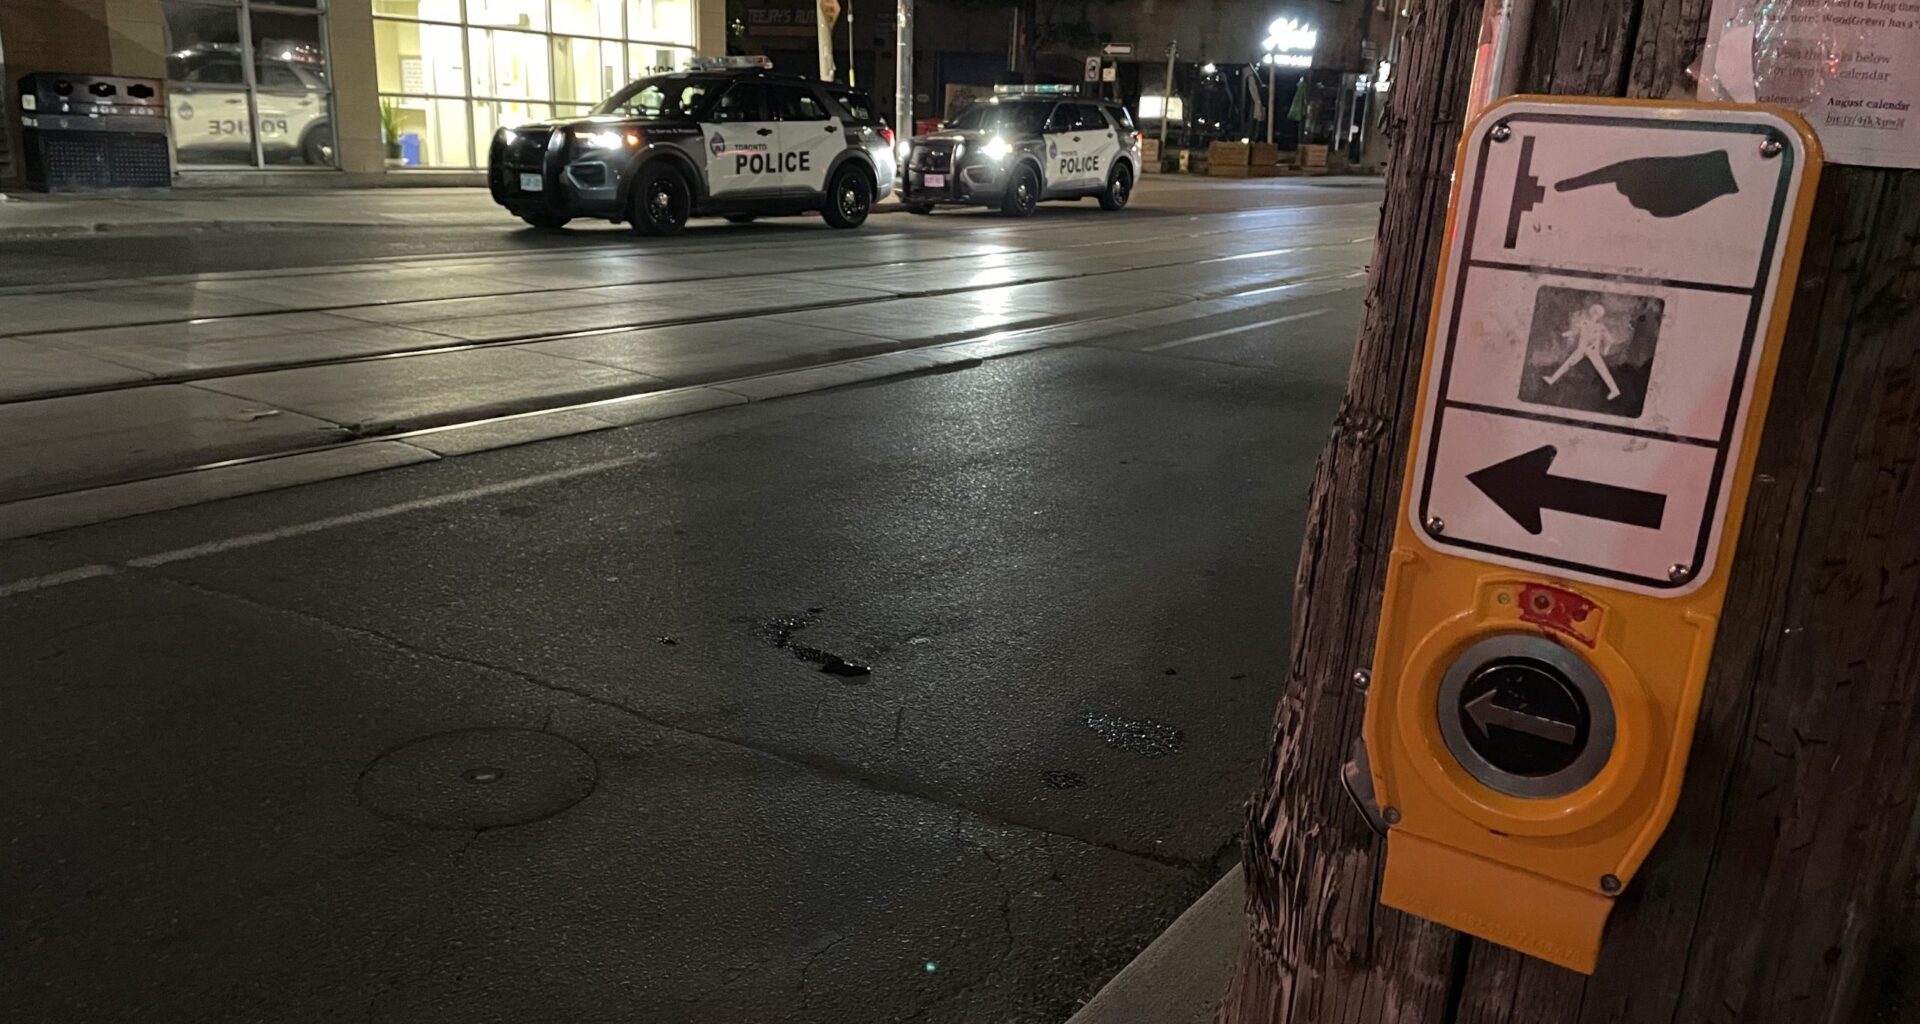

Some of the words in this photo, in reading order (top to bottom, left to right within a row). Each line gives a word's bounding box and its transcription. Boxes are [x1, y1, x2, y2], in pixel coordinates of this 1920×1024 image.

[1822, 14, 1887, 28] WoodGreen
[1855, 50, 1891, 64] below
[1840, 68, 1892, 82] calendar
[1827, 97, 1864, 109] August
[1866, 99, 1911, 112] calendar
[734, 143, 767, 151] TORONTO
[735, 151, 811, 175] POLICE
[1060, 155, 1099, 175] POLICE
